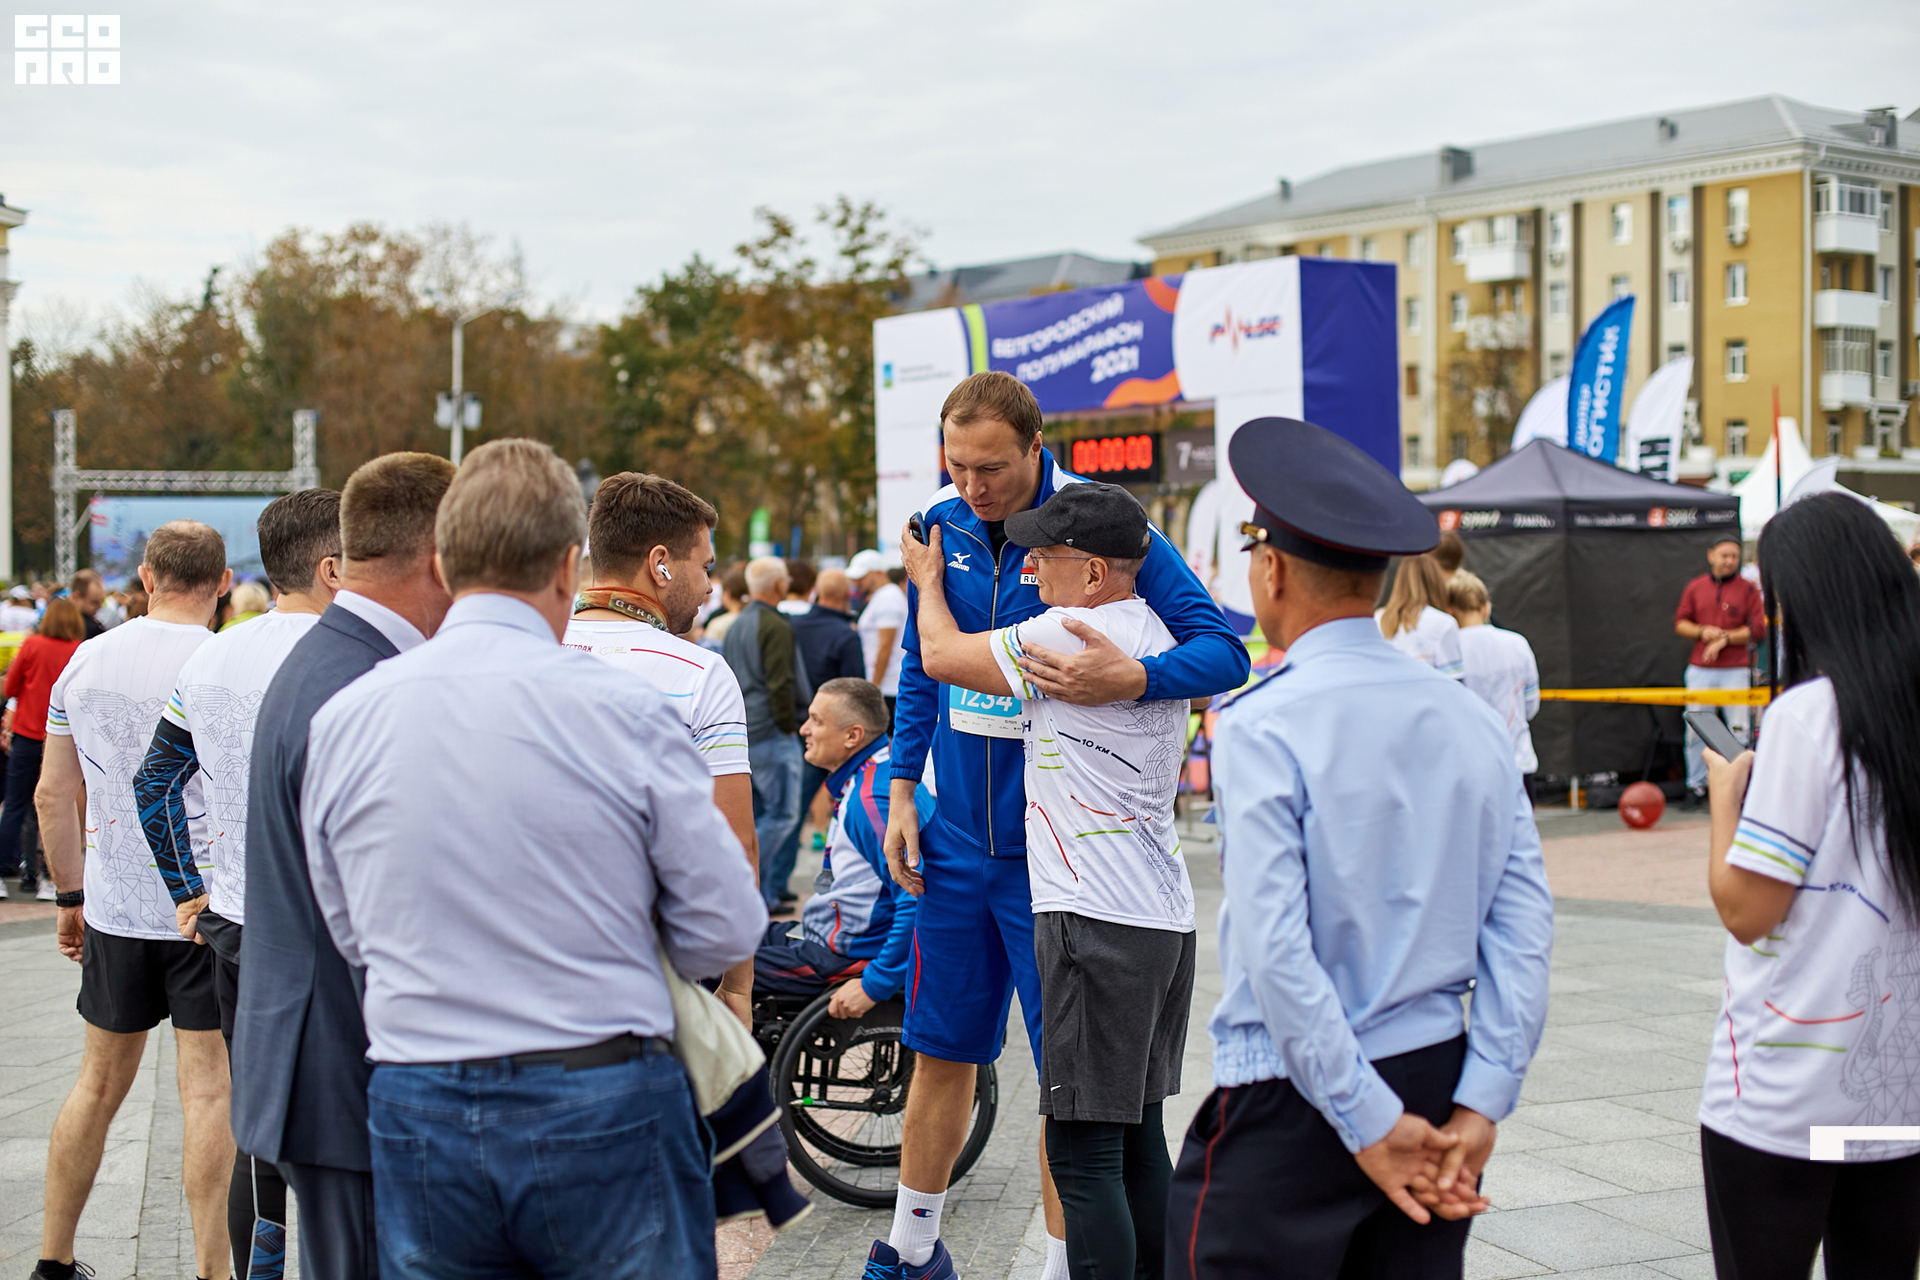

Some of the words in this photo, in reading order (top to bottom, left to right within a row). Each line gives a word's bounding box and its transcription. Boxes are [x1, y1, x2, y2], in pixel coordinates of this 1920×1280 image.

[992, 292, 1124, 358] БЕЛГОРОДСКИЙ
[1016, 320, 1143, 382] ПОЛУМАРАФОН
[1090, 345, 1139, 384] 2021
[615, 600, 670, 632] GERMA
[960, 688, 1013, 712] 1234
[1082, 739, 1094, 748] 10
